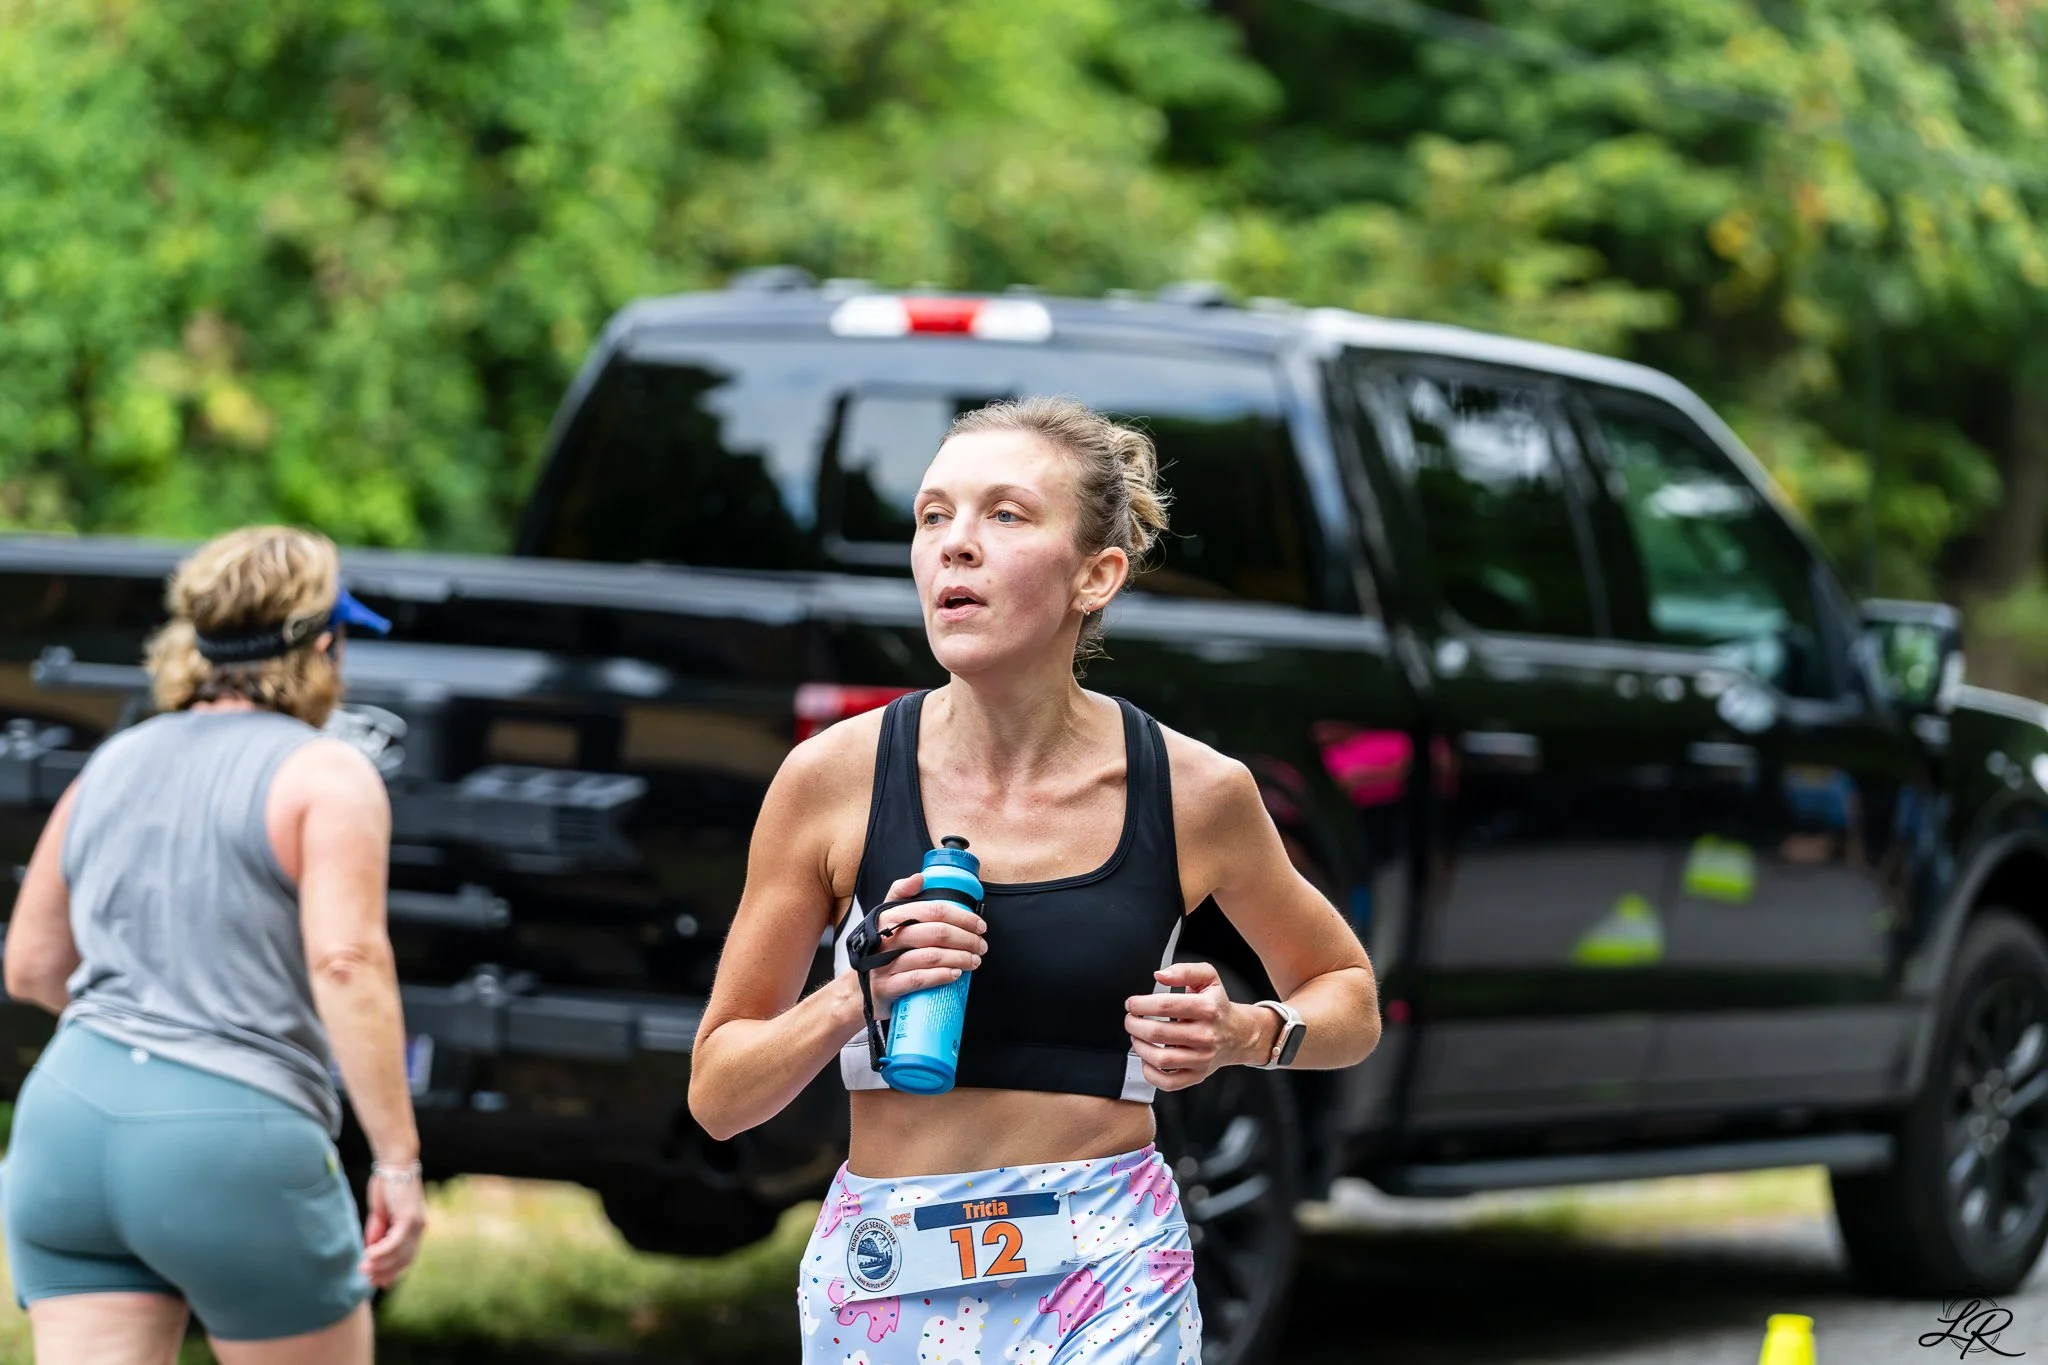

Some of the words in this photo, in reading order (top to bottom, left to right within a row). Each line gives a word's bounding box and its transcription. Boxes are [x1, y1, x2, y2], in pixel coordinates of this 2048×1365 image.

[963, 1199, 1008, 1220] Tricia
[850, 1234, 860, 1252] ROAD
[857, 1222, 869, 1235] RACE
[869, 1221, 887, 1232] SERIES
[949, 1221, 1028, 1281] 12
